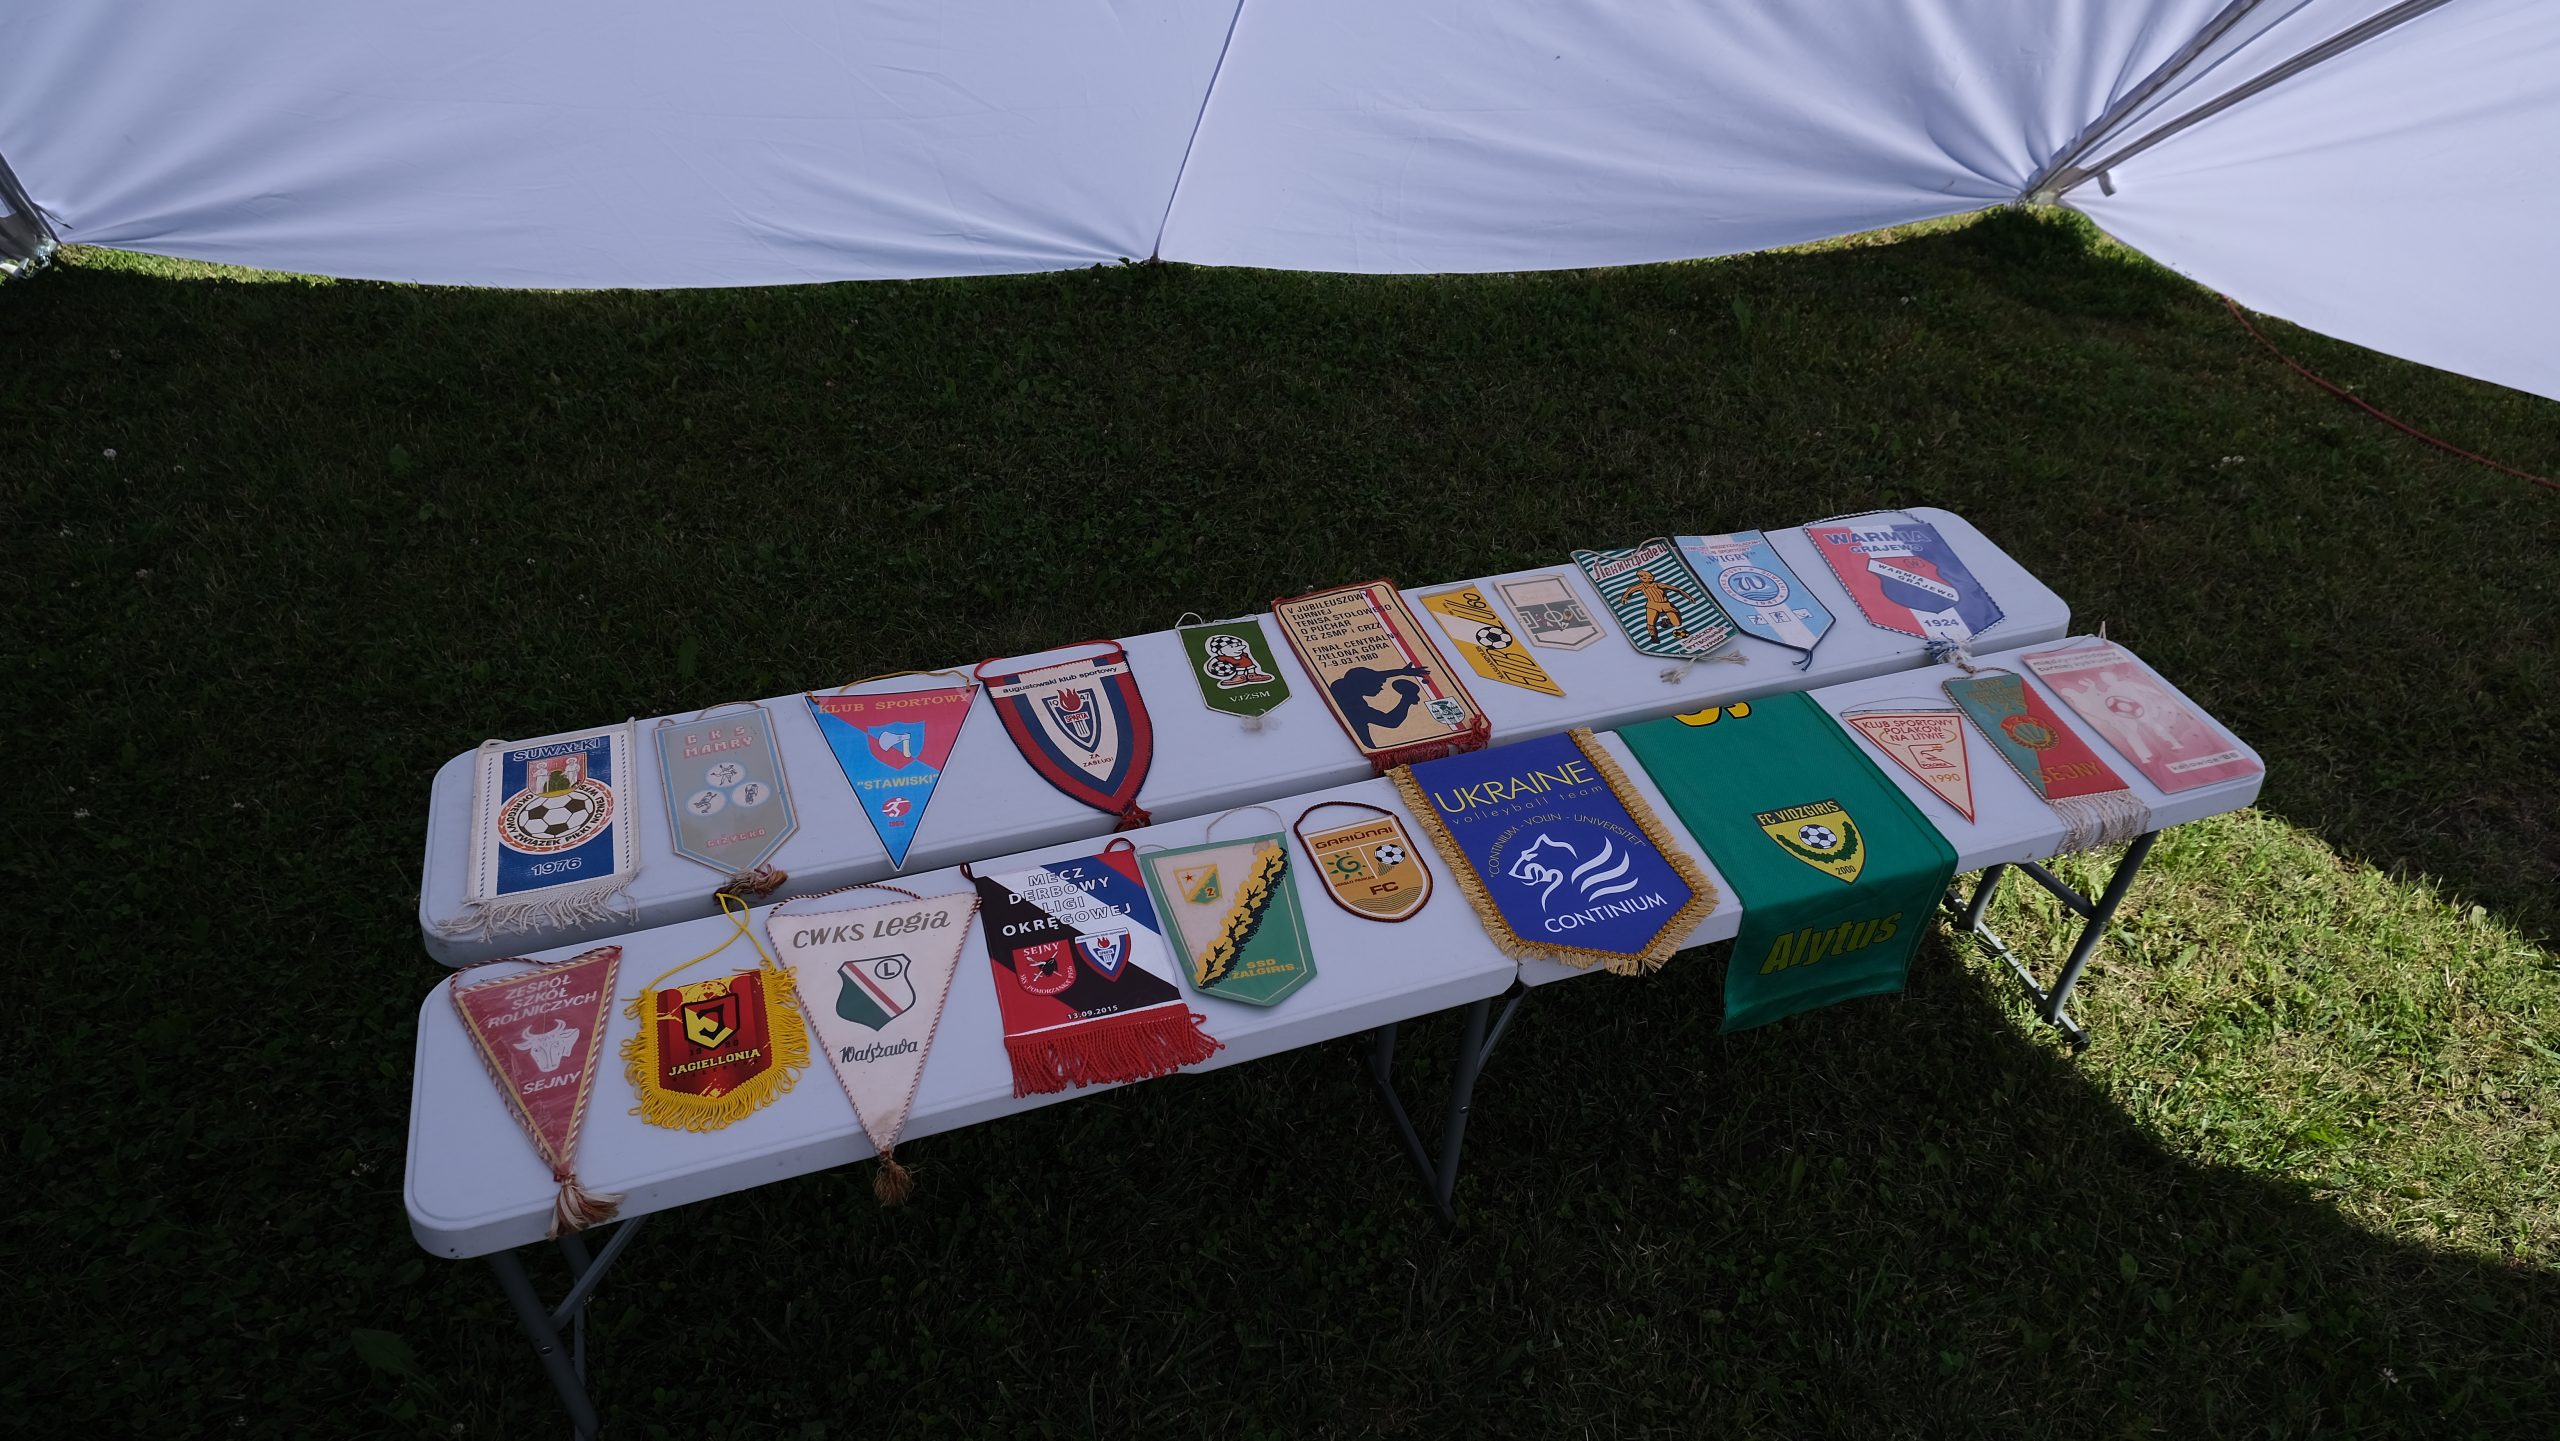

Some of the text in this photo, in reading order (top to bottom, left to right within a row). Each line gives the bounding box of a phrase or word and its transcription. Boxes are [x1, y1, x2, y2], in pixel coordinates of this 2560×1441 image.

[1823, 530, 1932, 545] WARMIA
[1850, 543, 1924, 553] GRAJEWO
[1878, 563, 1924, 582] WARMIA
[1898, 574, 1955, 599] GRAJEWO
[1287, 591, 1369, 615] V JUBILEUSZOWY
[1291, 609, 1332, 621] TURNIEJ
[1295, 616, 1332, 628] TENISA
[1924, 618, 1960, 628] 1924
[1300, 619, 1352, 636] O PUCHAR
[1304, 634, 1319, 642] ZG
[1321, 627, 1350, 640] ZSMP
[1357, 621, 1383, 633] CRZZ
[1343, 632, 1400, 648] CENTRALNY
[1317, 641, 1390, 662] ZIELONA GÓRA
[1321, 652, 1379, 668] 7-9.03.1980
[1002, 666, 1117, 694] augustowski klub sportowy
[818, 694, 970, 714] KLUB SPORTOWY
[1064, 712, 1089, 723] SPARTA
[1893, 719, 1953, 727] SPORTOWY
[684, 736, 753, 758] MAMRY
[1890, 734, 1907, 742] NA
[512, 737, 601, 762] SUWAŁKI
[1929, 773, 1961, 783] 1990
[2032, 759, 2104, 784] SEJNY
[1434, 760, 1594, 813] UKRAINE
[1452, 785, 1603, 825] volleyball team
[1757, 800, 1840, 825] FC VIDZGIRIS
[531, 857, 582, 876] 1976
[1835, 865, 1857, 876] 2000
[1028, 867, 1084, 887] MECZ
[1008, 876, 1110, 905] DERBOWY
[1369, 881, 1399, 896] FC
[1041, 897, 1085, 914] LIGI
[1544, 892, 1668, 933] CONTINIUM
[793, 910, 951, 949] CWKS Legia
[1002, 902, 1132, 937] OKRĘGOWEJ
[1023, 942, 1060, 957] SEJNY
[1758, 911, 1904, 976] Alytus
[883, 963, 896, 977] L
[1247, 959, 1276, 969] SSD
[506, 974, 573, 1000] ZESPÓŁ
[511, 987, 569, 1011] SZKÓŁ
[487, 991, 598, 1029] ROLNICZYCH
[1067, 1004, 1118, 1020] 13.09.2015
[840, 1039, 919, 1064] Warszawa
[668, 1048, 761, 1077] JAGIELLONIA
[522, 1071, 582, 1095] SEJNY
